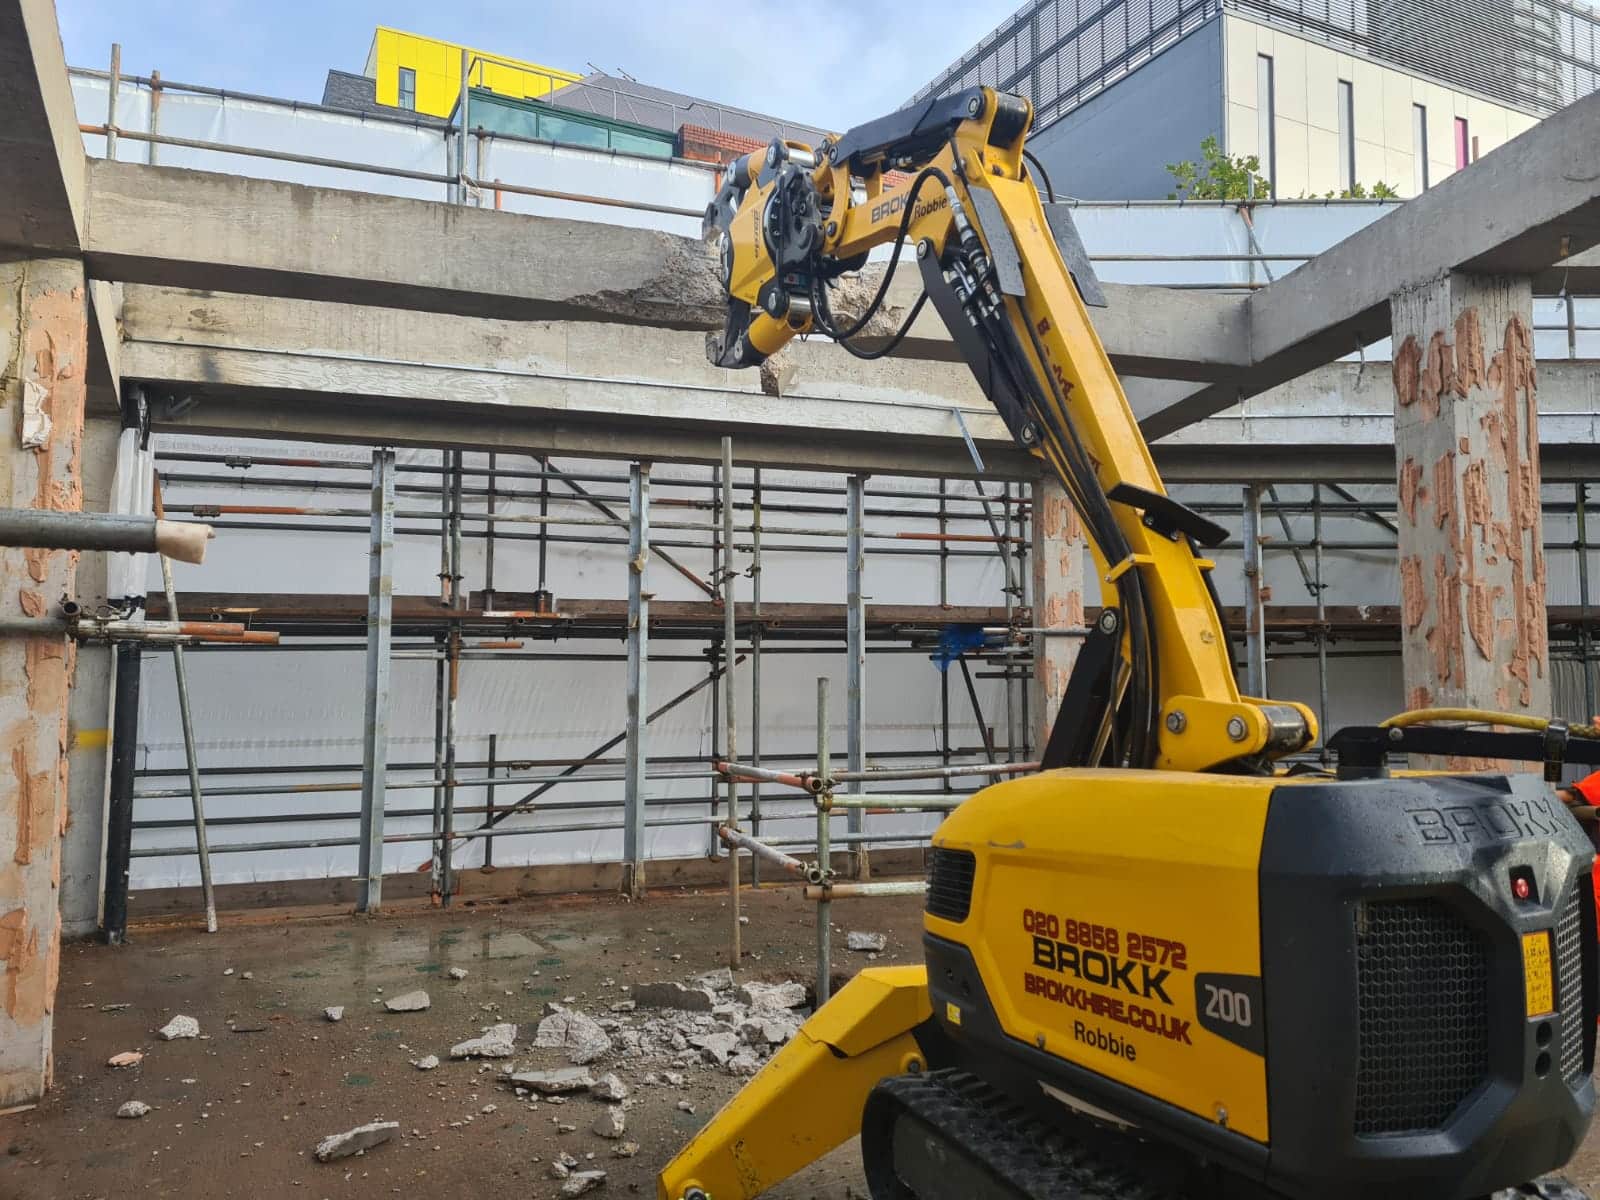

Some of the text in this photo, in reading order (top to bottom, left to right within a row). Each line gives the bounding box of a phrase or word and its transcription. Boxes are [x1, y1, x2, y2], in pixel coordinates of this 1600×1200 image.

[872, 191, 922, 224] BROK
[914, 197, 948, 220] Robbie
[1403, 798, 1568, 846] BROKK
[1023, 908, 1188, 970] 020 8858 2572
[1032, 936, 1175, 1006] BROKK
[1024, 972, 1193, 1046] BROKKHIRE.CO.UK
[1204, 983, 1252, 1027] 200
[1073, 1019, 1137, 1062] Robbie
